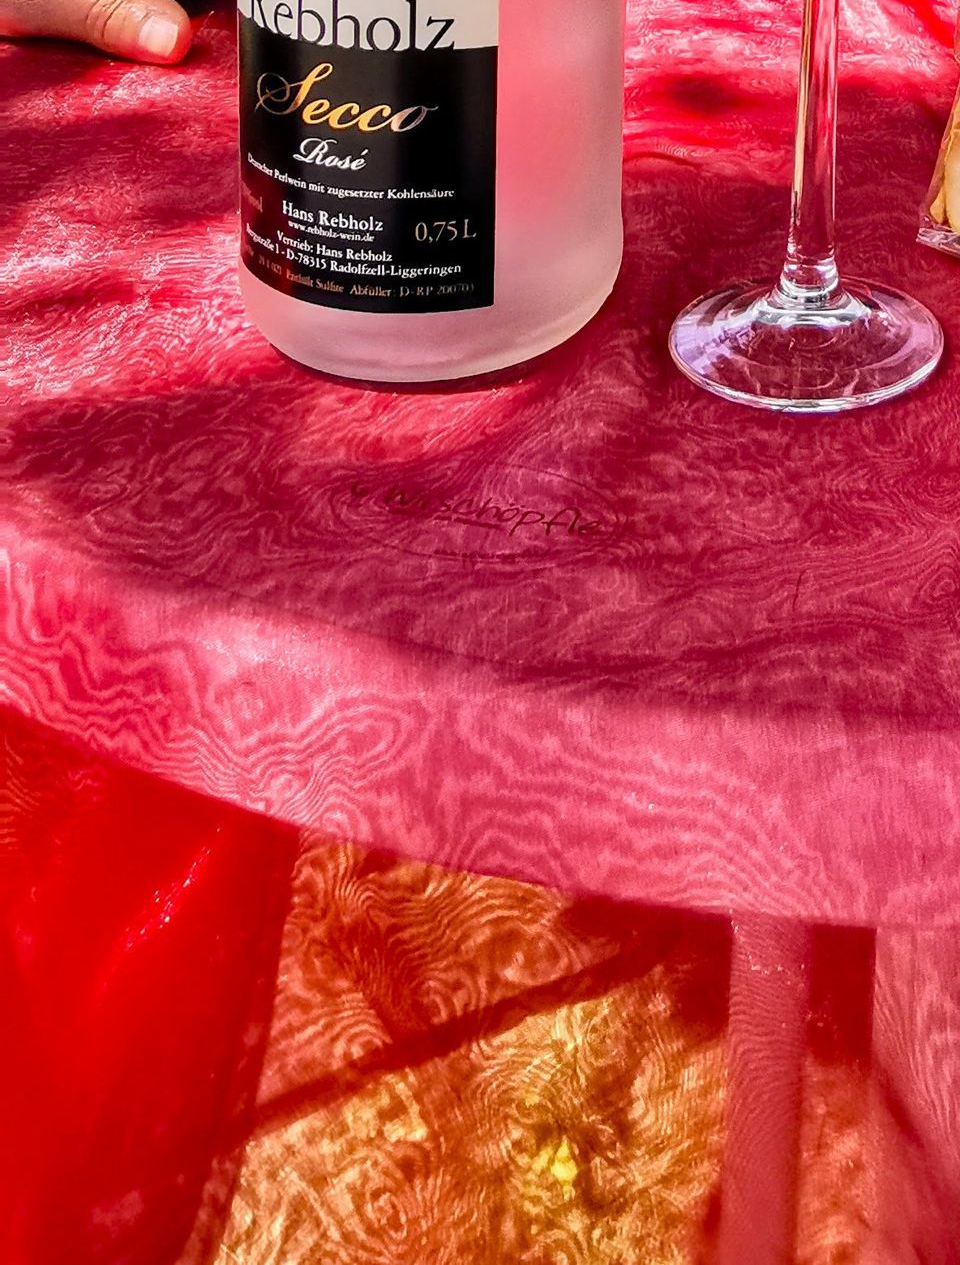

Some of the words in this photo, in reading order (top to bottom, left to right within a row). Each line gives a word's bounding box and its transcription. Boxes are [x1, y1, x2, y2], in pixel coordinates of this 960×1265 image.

[254, 62, 440, 133] Secco
[292, 137, 370, 171] Rosé
[308, 182, 325, 194] mit
[327, 186, 385, 199] zugesetzter
[386, 188, 455, 200] Kohlensäure
[282, 200, 314, 223] Hans
[318, 210, 384, 232] Rebholz
[288, 220, 375, 242] www.rebholz-wein.de
[415, 221, 459, 244] 0,75
[462, 219, 477, 239] L
[277, 229, 314, 253] Vertrieb:
[316, 243, 343, 259] Hans
[346, 248, 393, 262] Rebholz
[286, 248, 327, 270] D-78315
[330, 260, 462, 279] Radolfzell-Liggeringen
